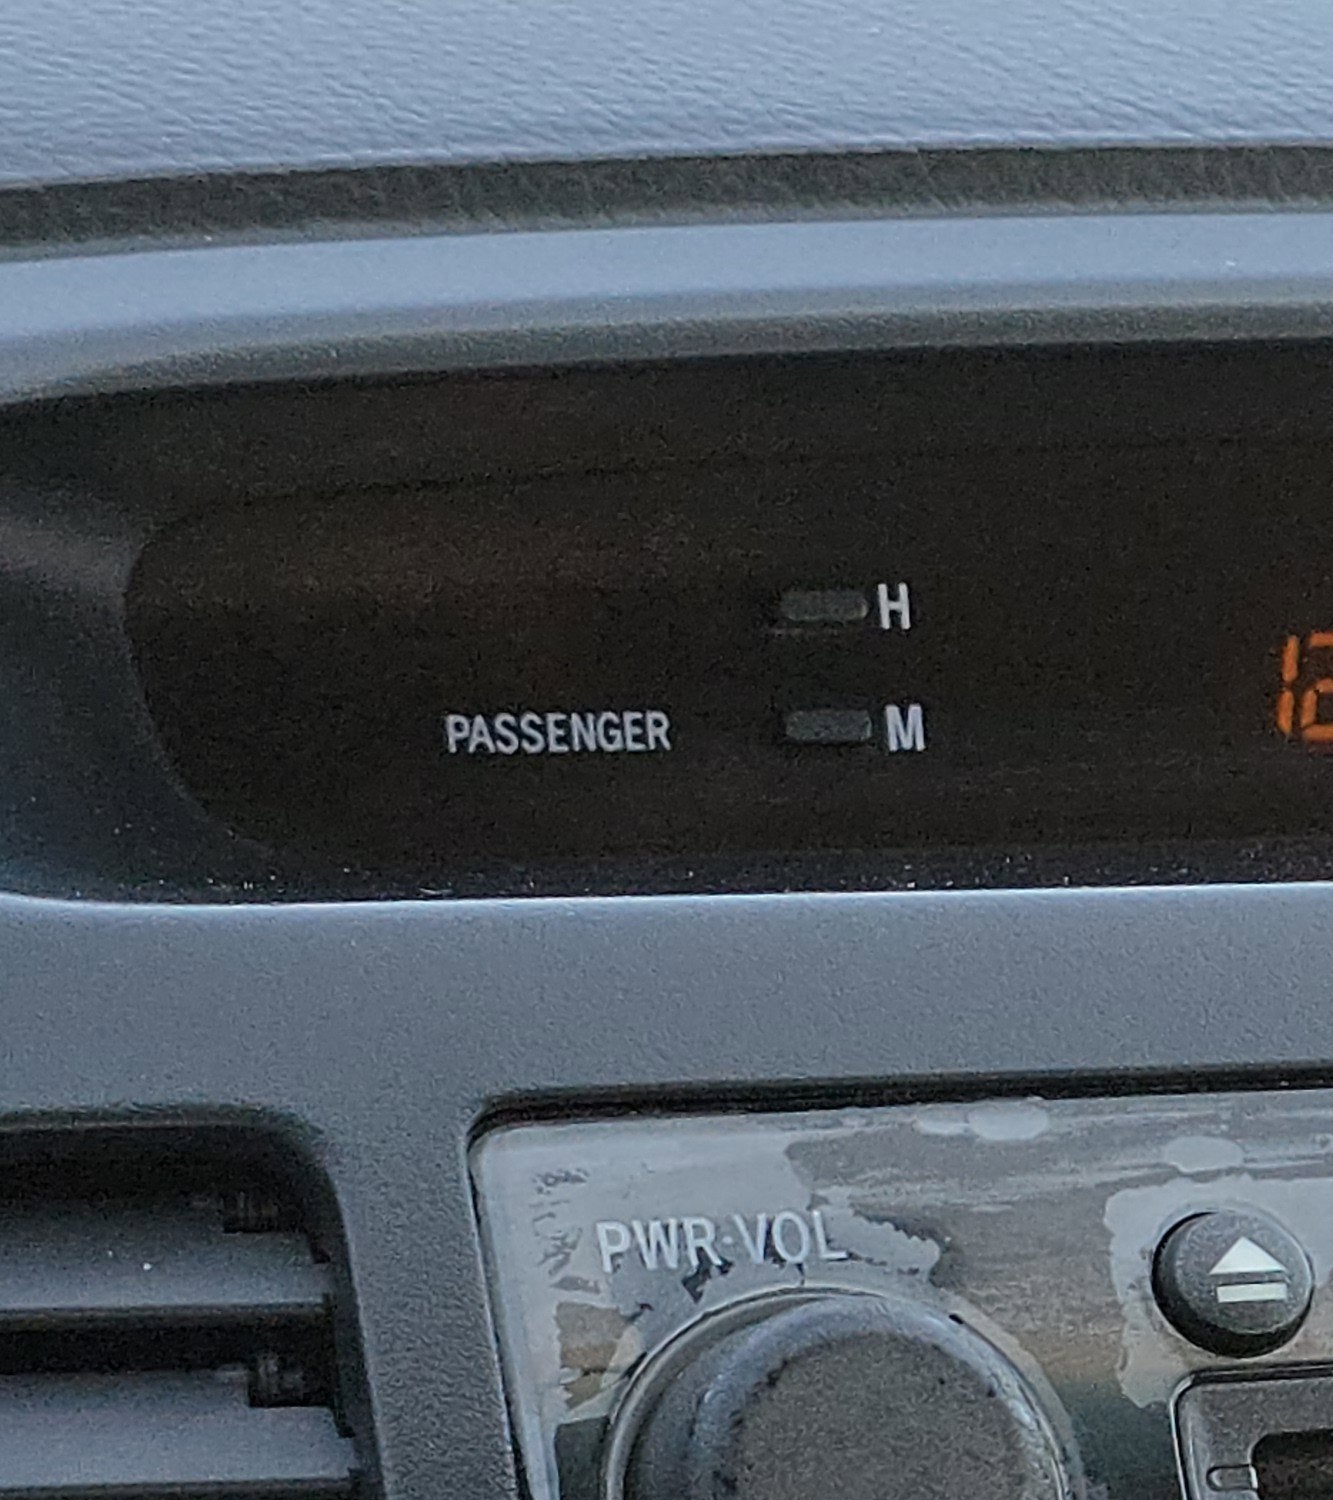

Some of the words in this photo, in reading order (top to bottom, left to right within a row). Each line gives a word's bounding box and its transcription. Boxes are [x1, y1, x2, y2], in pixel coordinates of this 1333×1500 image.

[876, 582, 912, 630] H
[446, 710, 671, 754] PASSENGER
[886, 704, 925, 752] M
